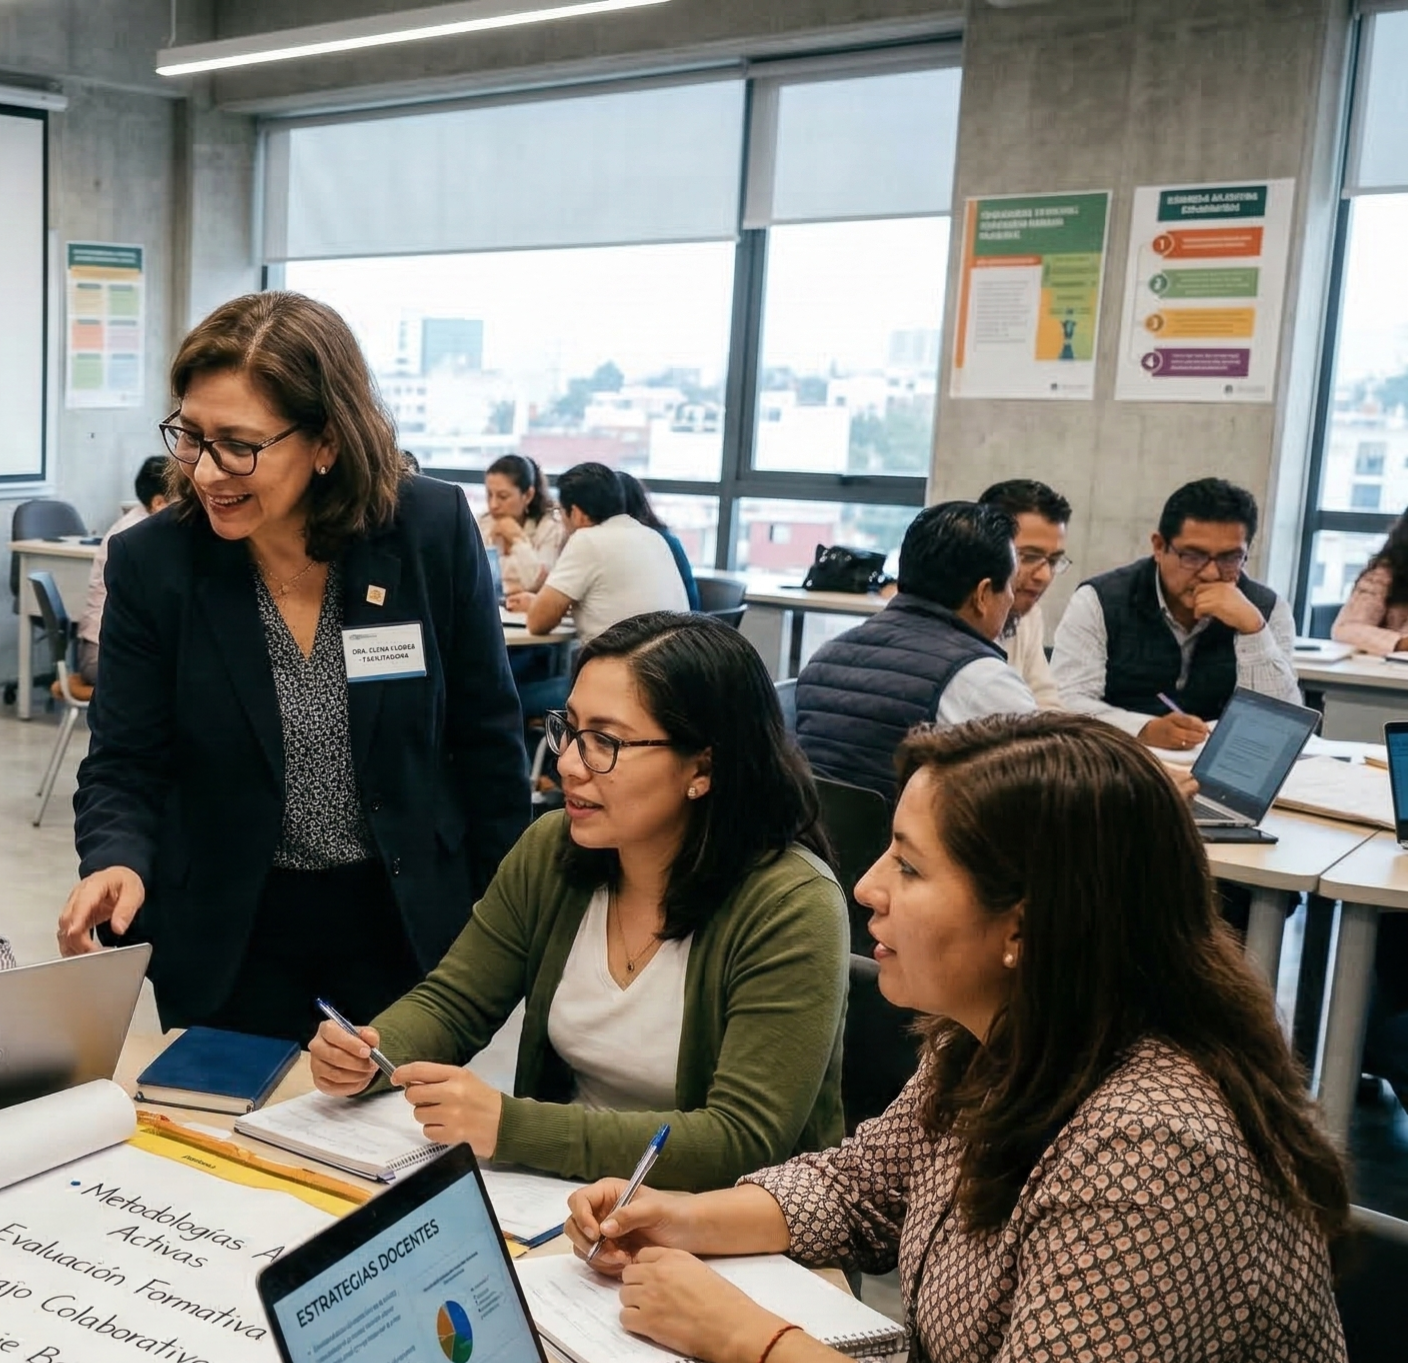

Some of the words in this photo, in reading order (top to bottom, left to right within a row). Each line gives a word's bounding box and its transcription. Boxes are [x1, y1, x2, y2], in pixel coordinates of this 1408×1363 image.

[81, 1182, 246, 1251] Metodologías
[106, 1225, 209, 1268] Activas
[295, 1259, 379, 1329] ESTRATEGIAS
[377, 1217, 440, 1271] DOCENTES
[133, 1278, 268, 1341] Formativa
